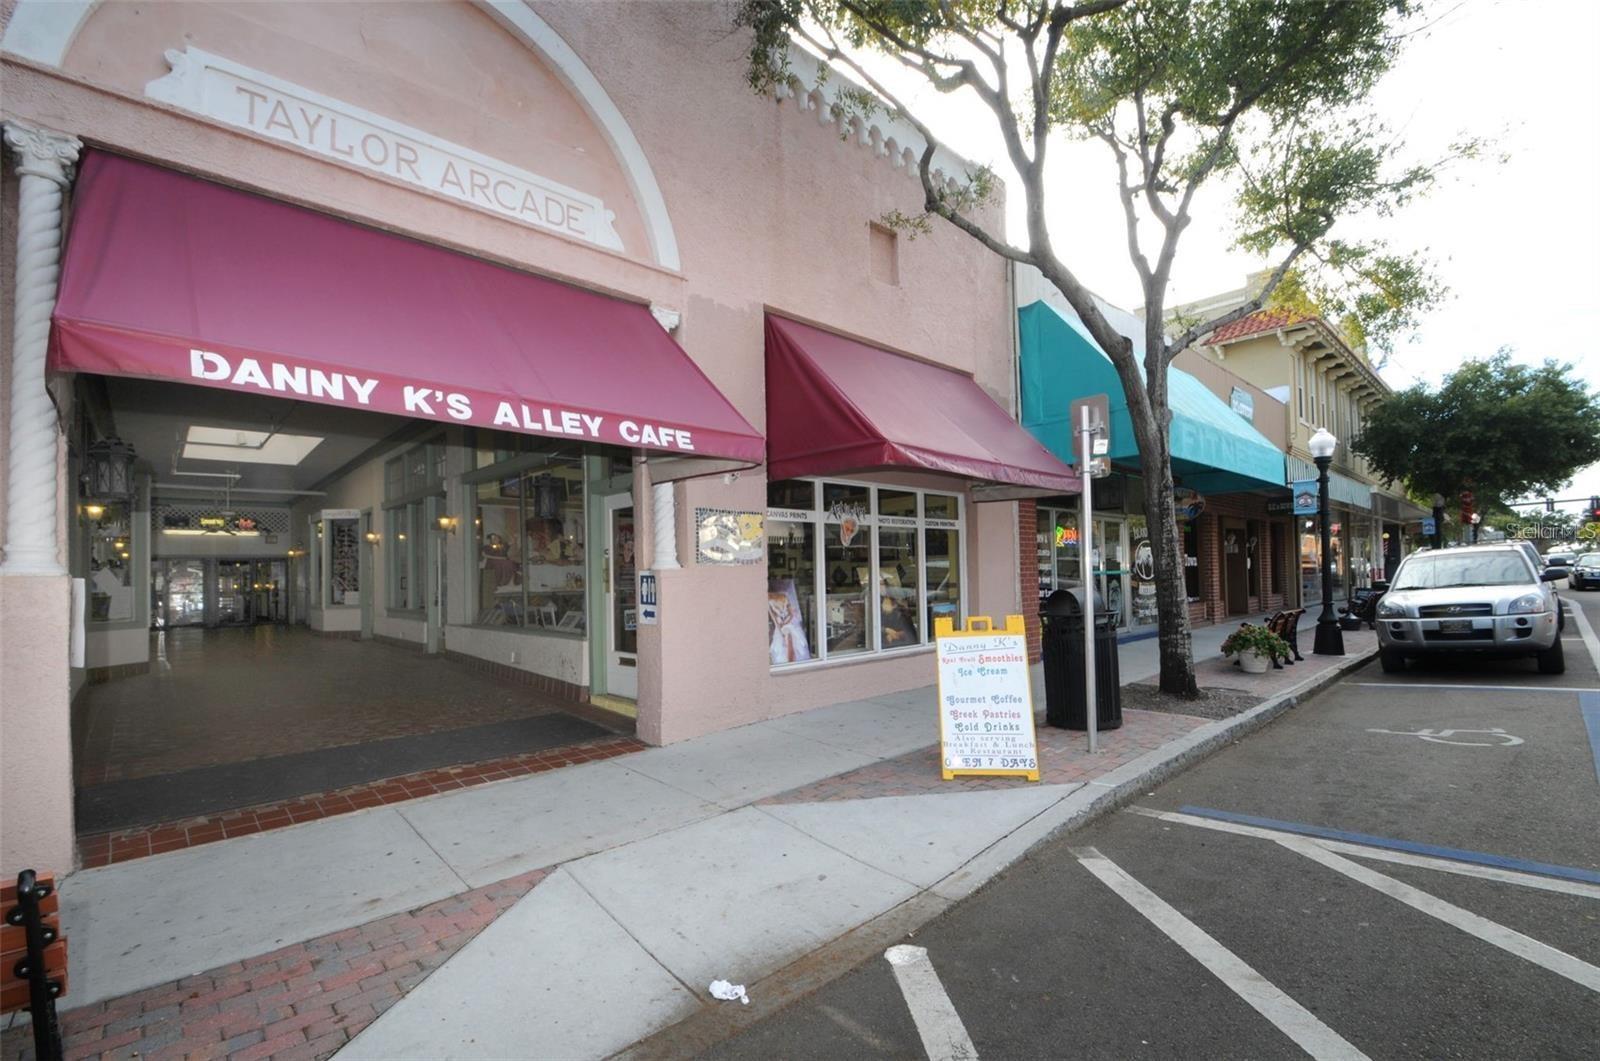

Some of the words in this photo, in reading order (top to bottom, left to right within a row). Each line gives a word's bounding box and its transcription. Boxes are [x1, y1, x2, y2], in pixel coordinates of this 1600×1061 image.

[236, 86, 422, 181] TAYLOR
[440, 160, 587, 236] ARCADE
[189, 348, 379, 408] DANNY
[403, 385, 473, 421] K'S
[493, 401, 605, 438] ALLEY
[618, 419, 695, 451] CAFE
[767, 510, 788, 519] CANVAS
[789, 511, 808, 520] PRINTS
[943, 642, 987, 652] Danny
[993, 637, 1018, 648] K's
[978, 654, 1024, 665] Smoothies
[957, 667, 973, 677] Ice
[976, 665, 1008, 677] Cream
[945, 695, 986, 706] Gourmet
[990, 694, 1023, 705] Coffee
[949, 709, 978, 720] Greek
[982, 709, 1021, 719] Pastries
[954, 722, 979, 732] Cold
[983, 722, 1020, 732] Drinks
[988, 757, 994, 766] 7
[1000, 758, 1037, 768] DAYS
